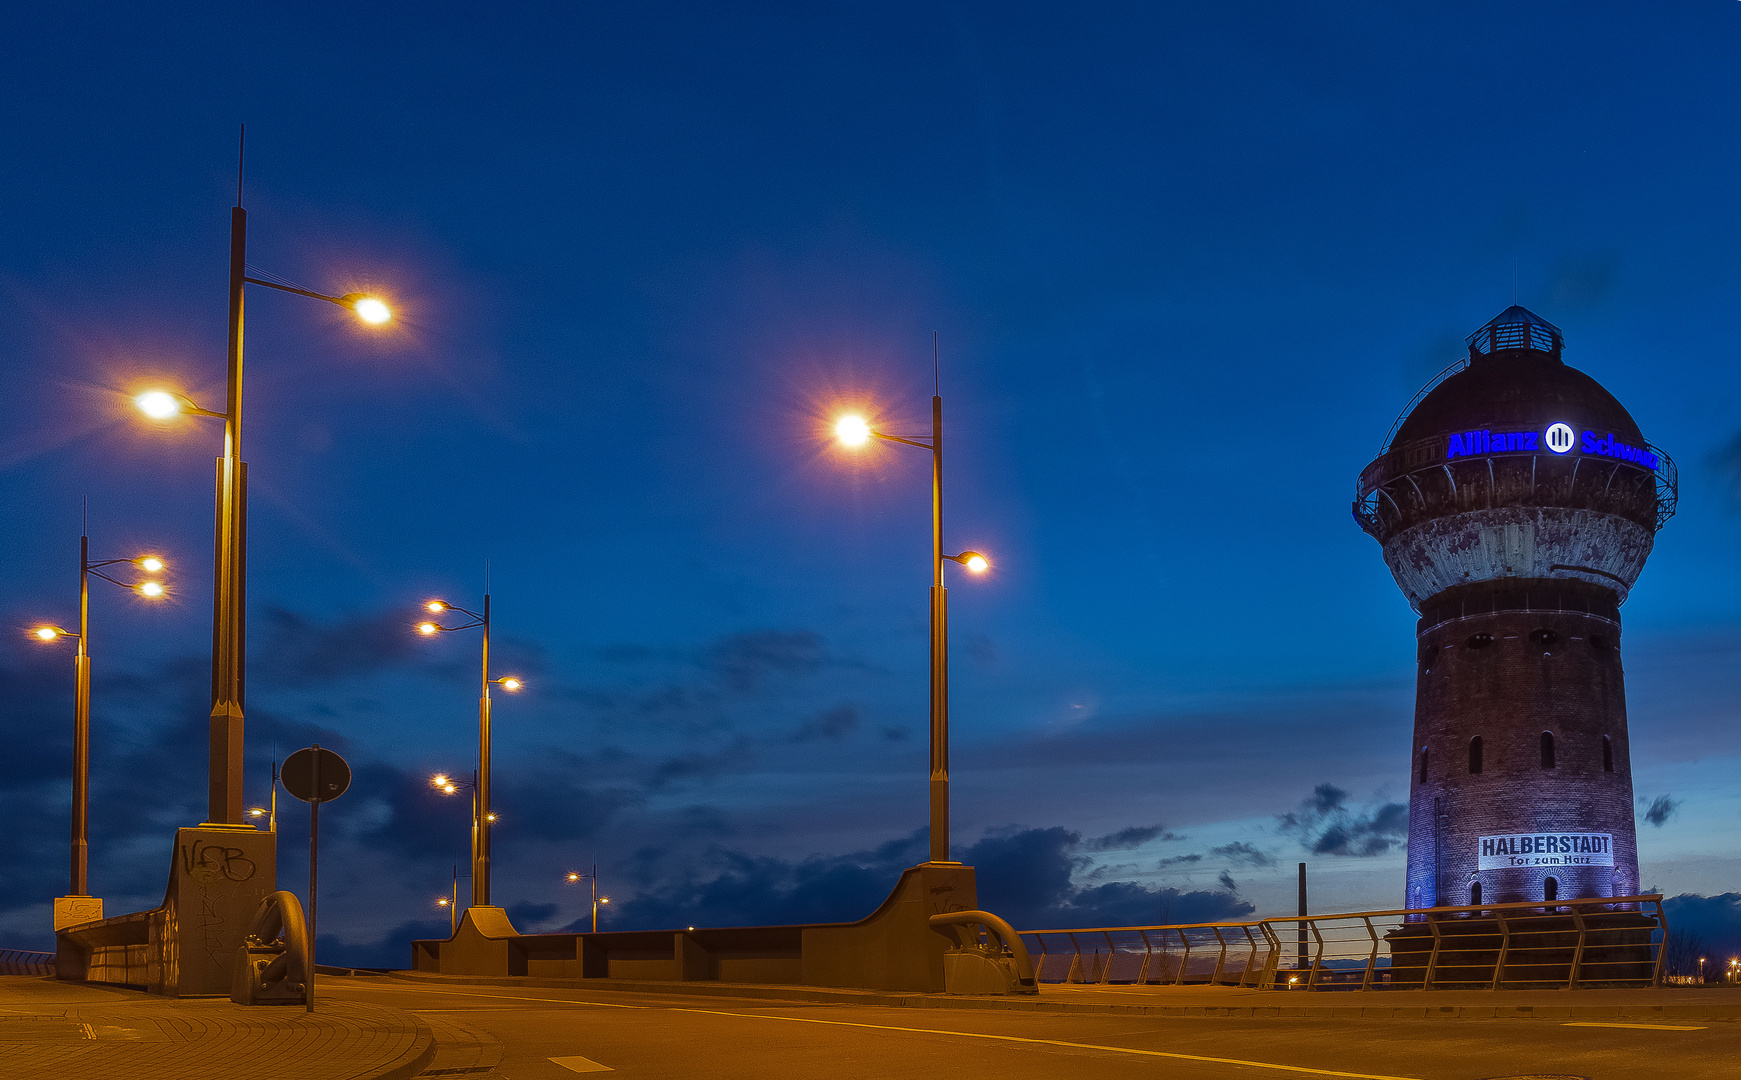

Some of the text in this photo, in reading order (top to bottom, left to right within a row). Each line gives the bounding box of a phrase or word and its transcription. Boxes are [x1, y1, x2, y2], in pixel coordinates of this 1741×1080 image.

[1447, 429, 1539, 459] Allianz
[1482, 836, 1609, 856] HALBERSTADT
[1509, 855, 1591, 866] Tor zum Harz
